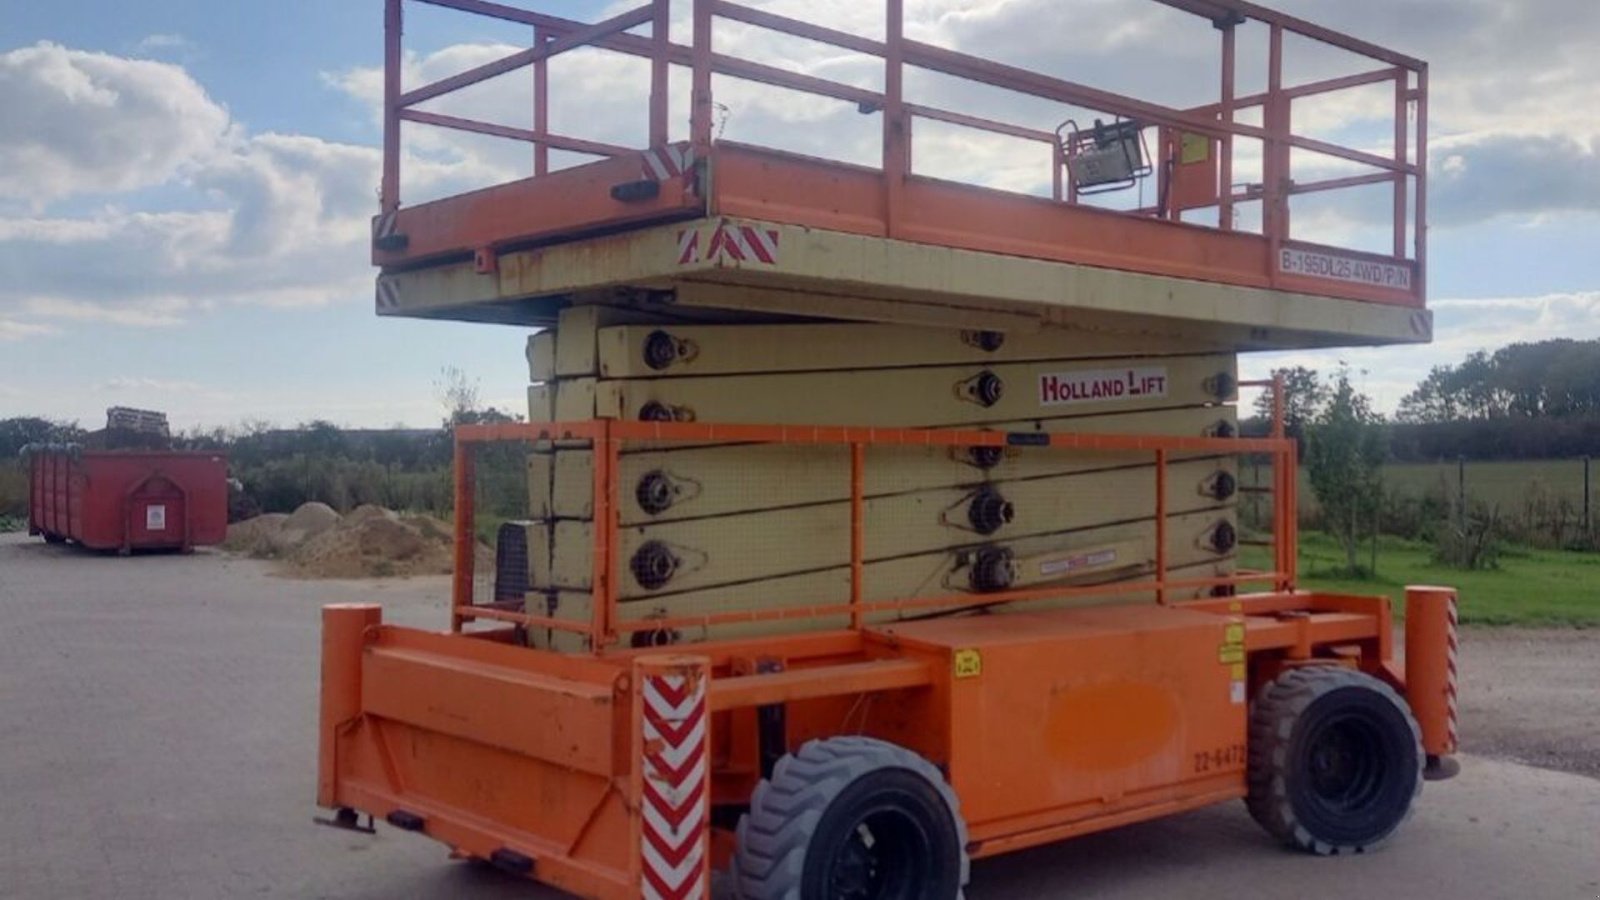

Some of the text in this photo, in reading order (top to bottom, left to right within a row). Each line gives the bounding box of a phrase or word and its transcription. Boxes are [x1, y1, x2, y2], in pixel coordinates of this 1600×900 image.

[1041, 370, 1165, 401] HOLLAND LIFT
[1194, 745, 1246, 773] 22-6472
